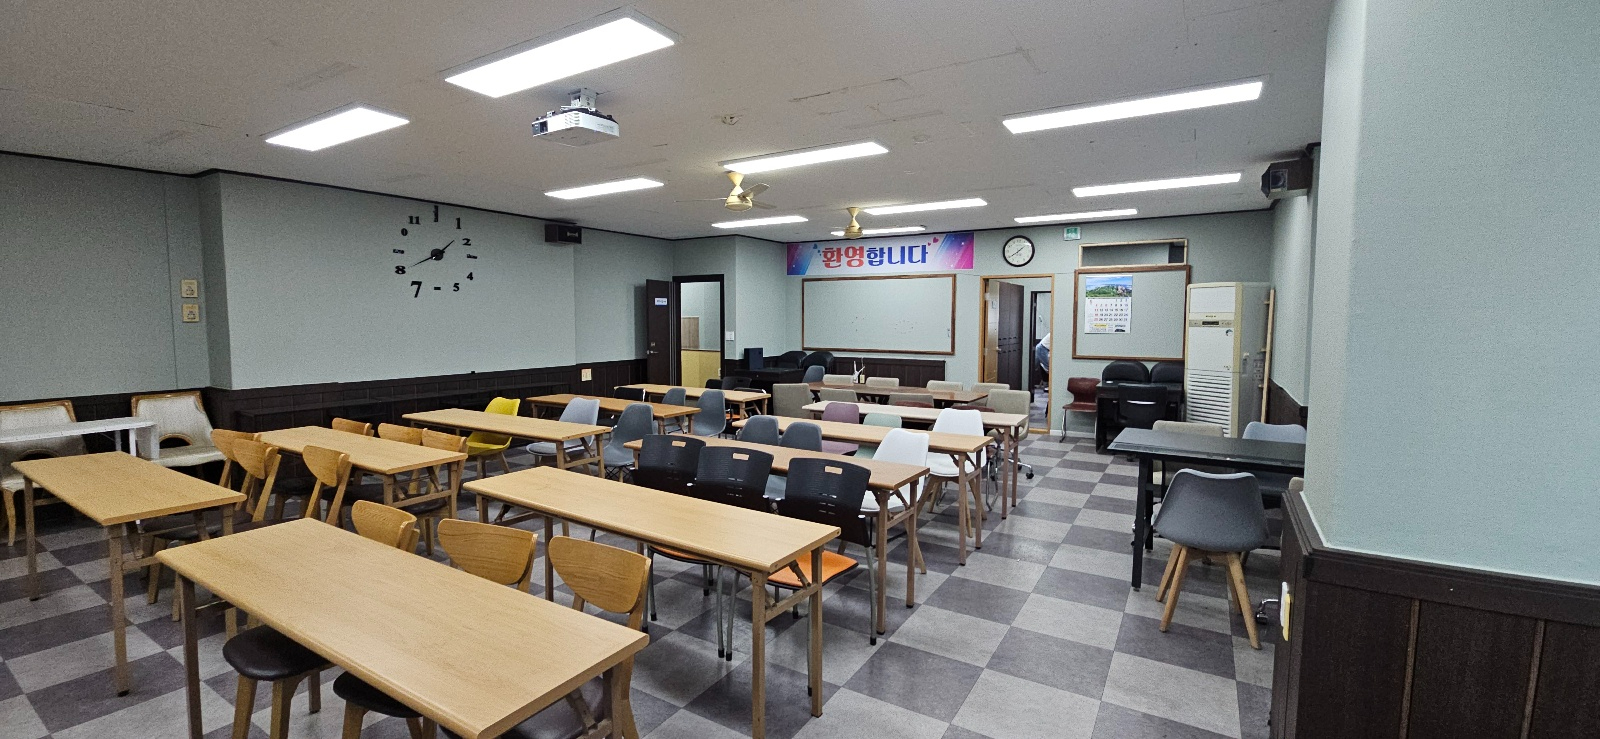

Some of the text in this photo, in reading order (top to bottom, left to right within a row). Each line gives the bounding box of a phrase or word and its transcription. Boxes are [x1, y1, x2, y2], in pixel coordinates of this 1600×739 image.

[408, 215, 421, 225] 11
[456, 218, 462, 230] 1
[462, 238, 472, 246] 2
[821, 244, 929, 269] 환영합니다
[394, 265, 406, 275] 8
[466, 272, 474, 281] 4
[410, 281, 423, 298] 7
[452, 282, 460, 292] 5
